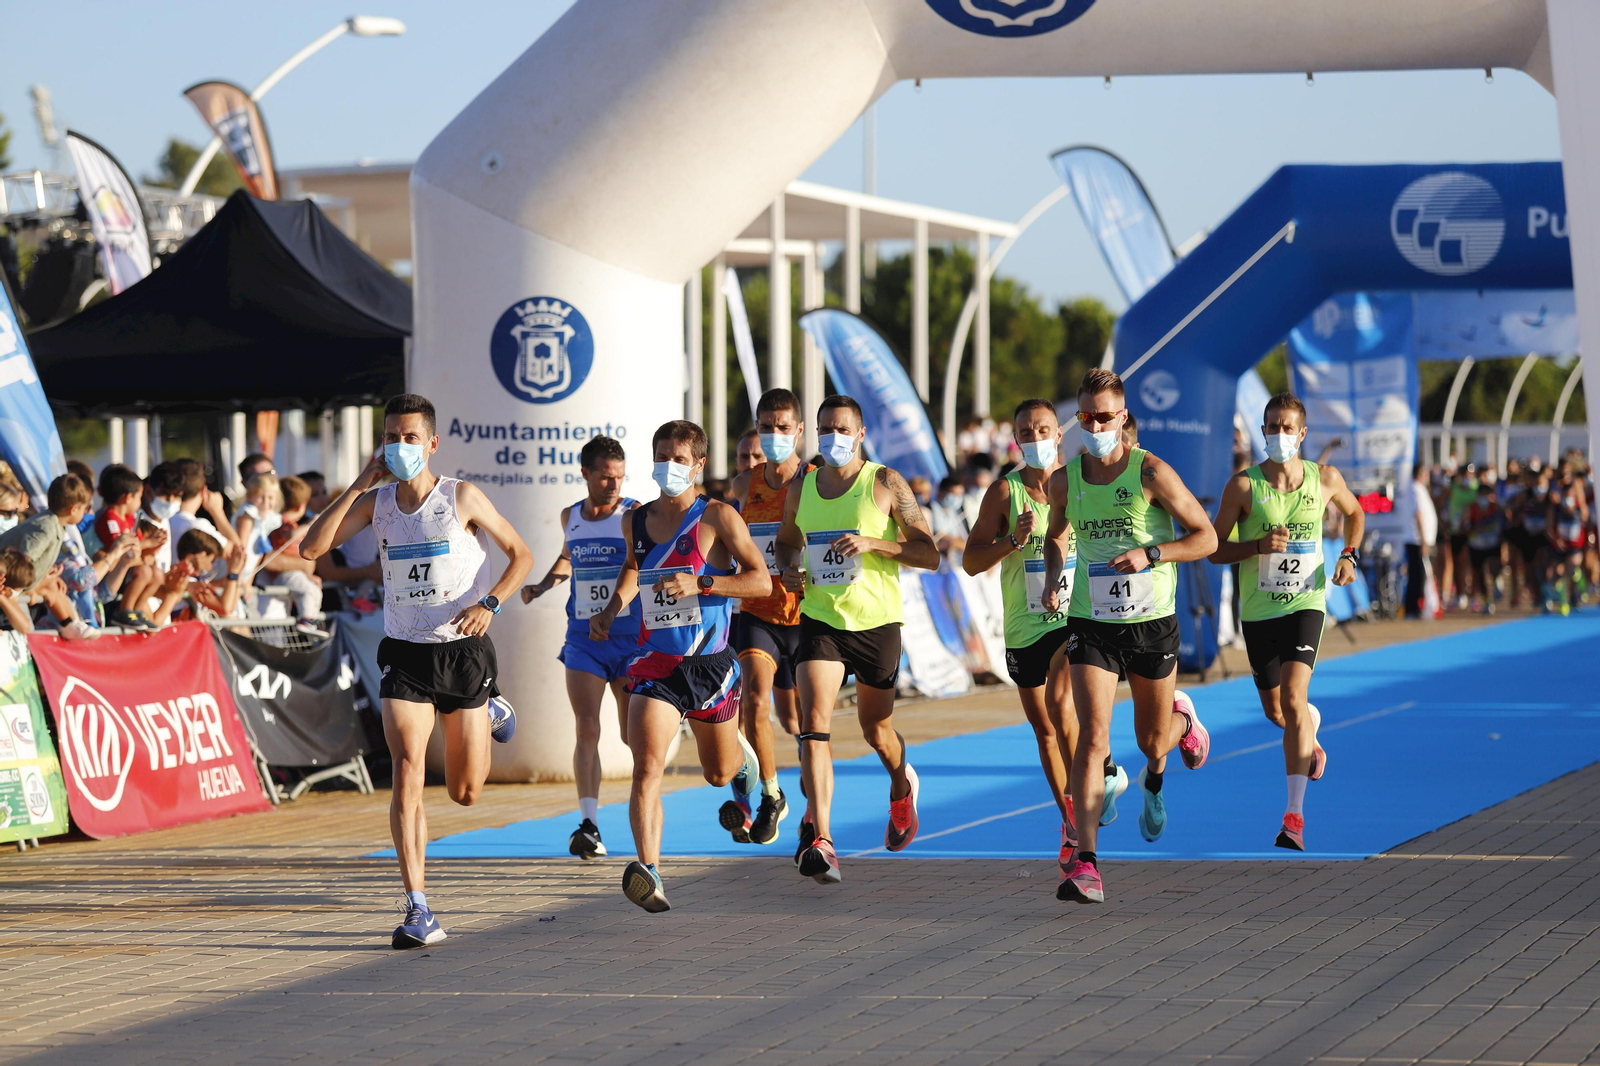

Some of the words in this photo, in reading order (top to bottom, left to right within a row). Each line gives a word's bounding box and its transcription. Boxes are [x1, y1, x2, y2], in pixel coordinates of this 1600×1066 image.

[1527, 206, 1568, 239] Pu
[449, 418, 627, 443] Ayuntamiento
[496, 447, 527, 465] de
[539, 472, 558, 485] de
[1079, 516, 1133, 530] Universo
[1089, 527, 1133, 540] Running
[572, 546, 617, 558] Beiman
[823, 549, 844, 565] 46
[408, 563, 431, 582] 47
[1278, 559, 1300, 574] 42
[410, 589, 436, 598] KIA
[590, 585, 609, 600] 50
[1109, 580, 1131, 598] 41
[654, 590, 677, 606] 45
[1110, 605, 1135, 613] KIA
[655, 613, 680, 622] KIA
[65, 703, 121, 780] KIA
[123, 692, 233, 771] VEYSER
[197, 764, 246, 802] HUELVA
